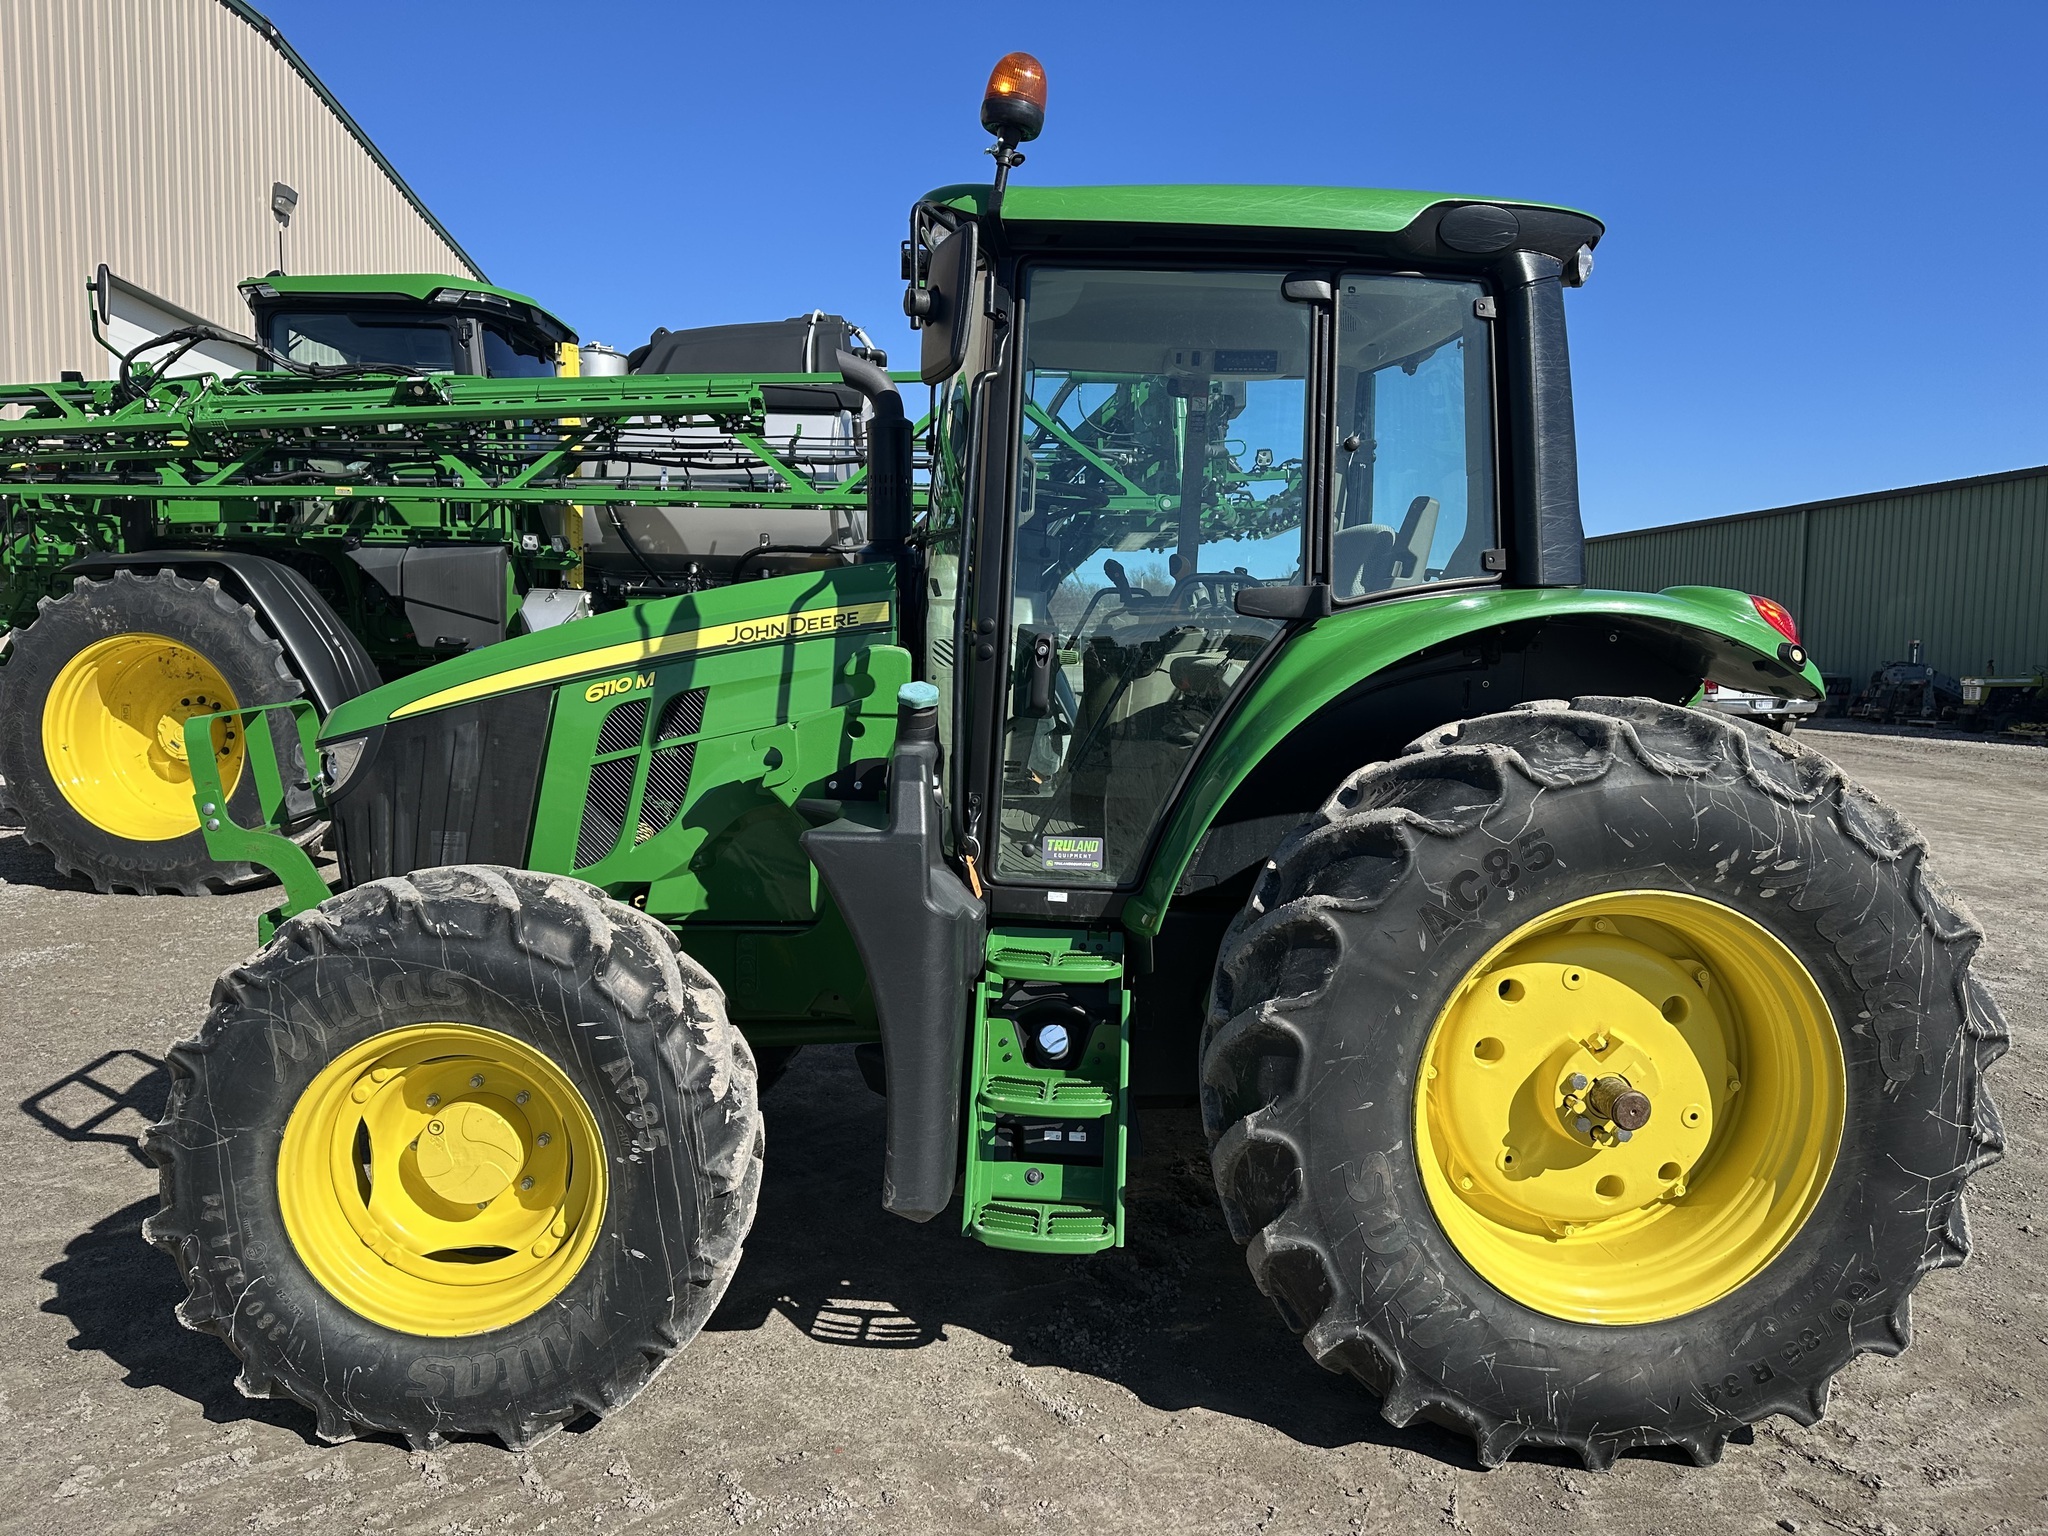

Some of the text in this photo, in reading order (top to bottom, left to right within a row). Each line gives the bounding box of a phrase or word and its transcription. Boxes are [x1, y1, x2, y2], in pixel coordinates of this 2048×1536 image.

[726, 610, 859, 646] JOHN DEERE
[585, 671, 656, 703] 6110 M
[1048, 840, 1099, 852] TRULAND
[264, 970, 469, 1083] Mitas
[404, 1281, 610, 1398] Mitas
